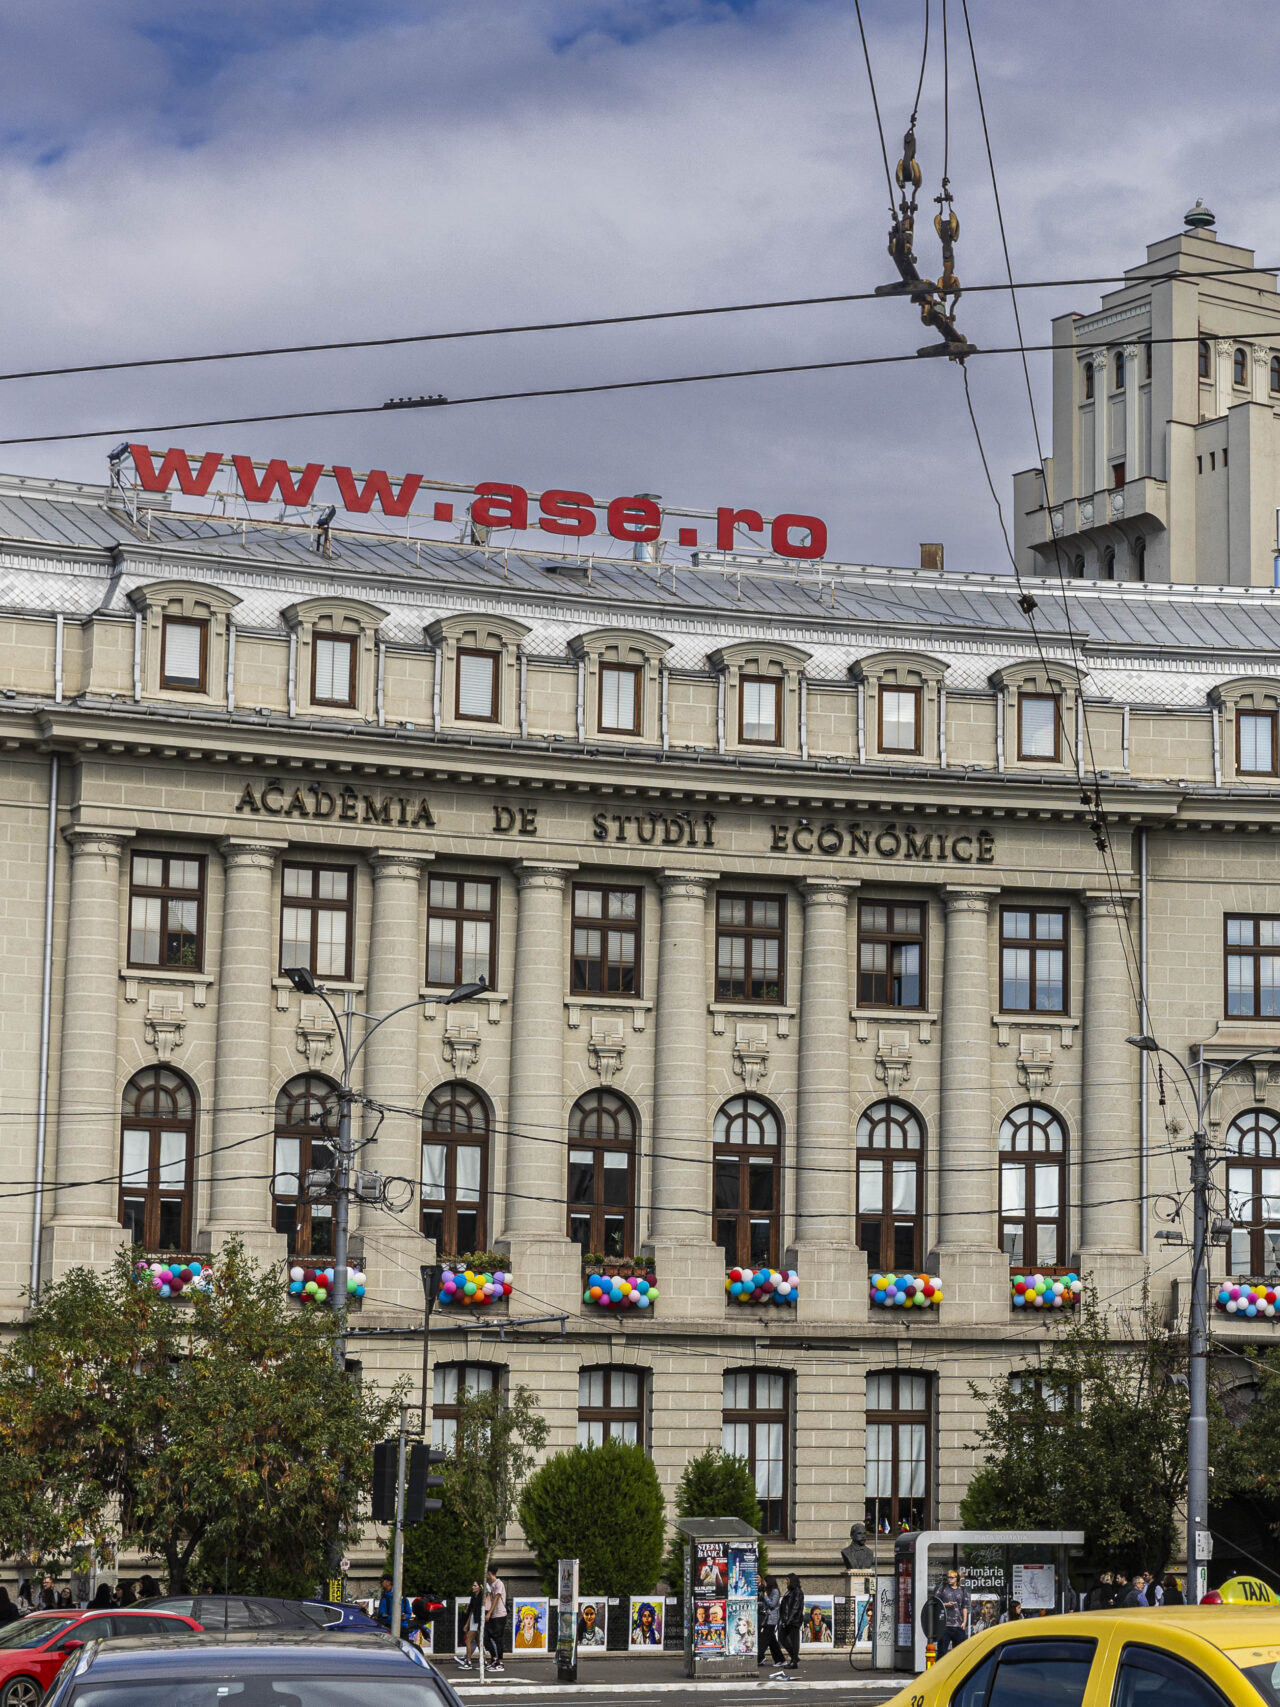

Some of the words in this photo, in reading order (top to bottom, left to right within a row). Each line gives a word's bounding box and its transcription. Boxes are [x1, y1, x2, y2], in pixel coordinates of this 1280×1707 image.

[129, 444, 828, 560] www.ase.ro
[234, 782, 436, 827] ACADEMIA
[492, 805, 538, 835] DE
[592, 812, 716, 846] STUDII
[770, 823, 996, 862] ECONOMICE
[959, 1565, 1004, 1576] Primăria
[1237, 1581, 1271, 1603] TAXI
